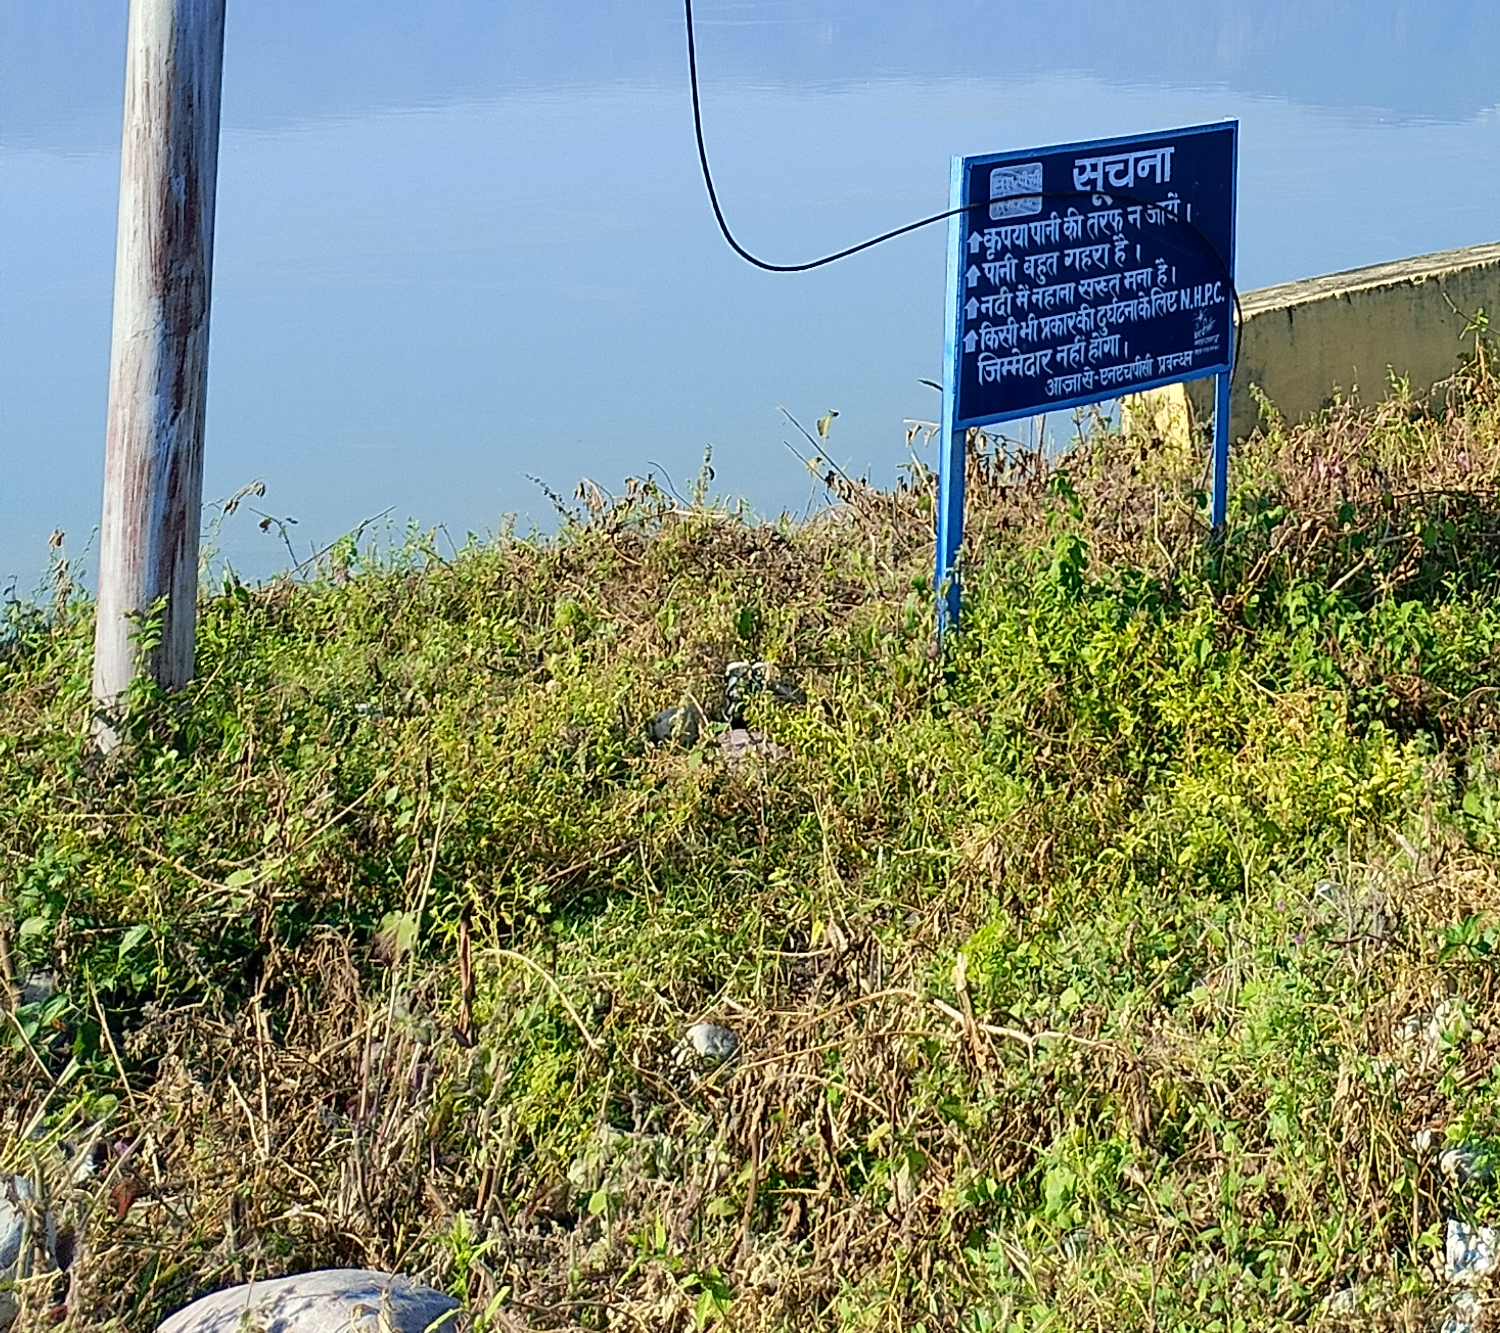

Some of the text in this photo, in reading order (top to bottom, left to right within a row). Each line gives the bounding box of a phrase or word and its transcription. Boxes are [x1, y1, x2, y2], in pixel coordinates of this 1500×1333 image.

[1072, 146, 1175, 206] सूचना
[1029, 211, 1062, 246] पानी
[1063, 207, 1085, 242] की
[1087, 209, 1123, 240] तरफ
[1127, 205, 1143, 229] न
[982, 252, 1018, 286] पानी
[1023, 252, 1060, 284] बहुत
[1063, 243, 1111, 271] गहरा
[981, 286, 1014, 317] नदी
[1015, 284, 1030, 311] में
[1031, 282, 1076, 310] नहाना
[1124, 268, 1154, 291] मना
[979, 316, 1019, 351] किसी
[1020, 313, 1039, 342] भी
[1039, 312, 1077, 340] प्रकार
[1076, 303, 1096, 332] की
[977, 348, 1054, 386] जिम्मेदार
[1056, 335, 1087, 368] नहीं
